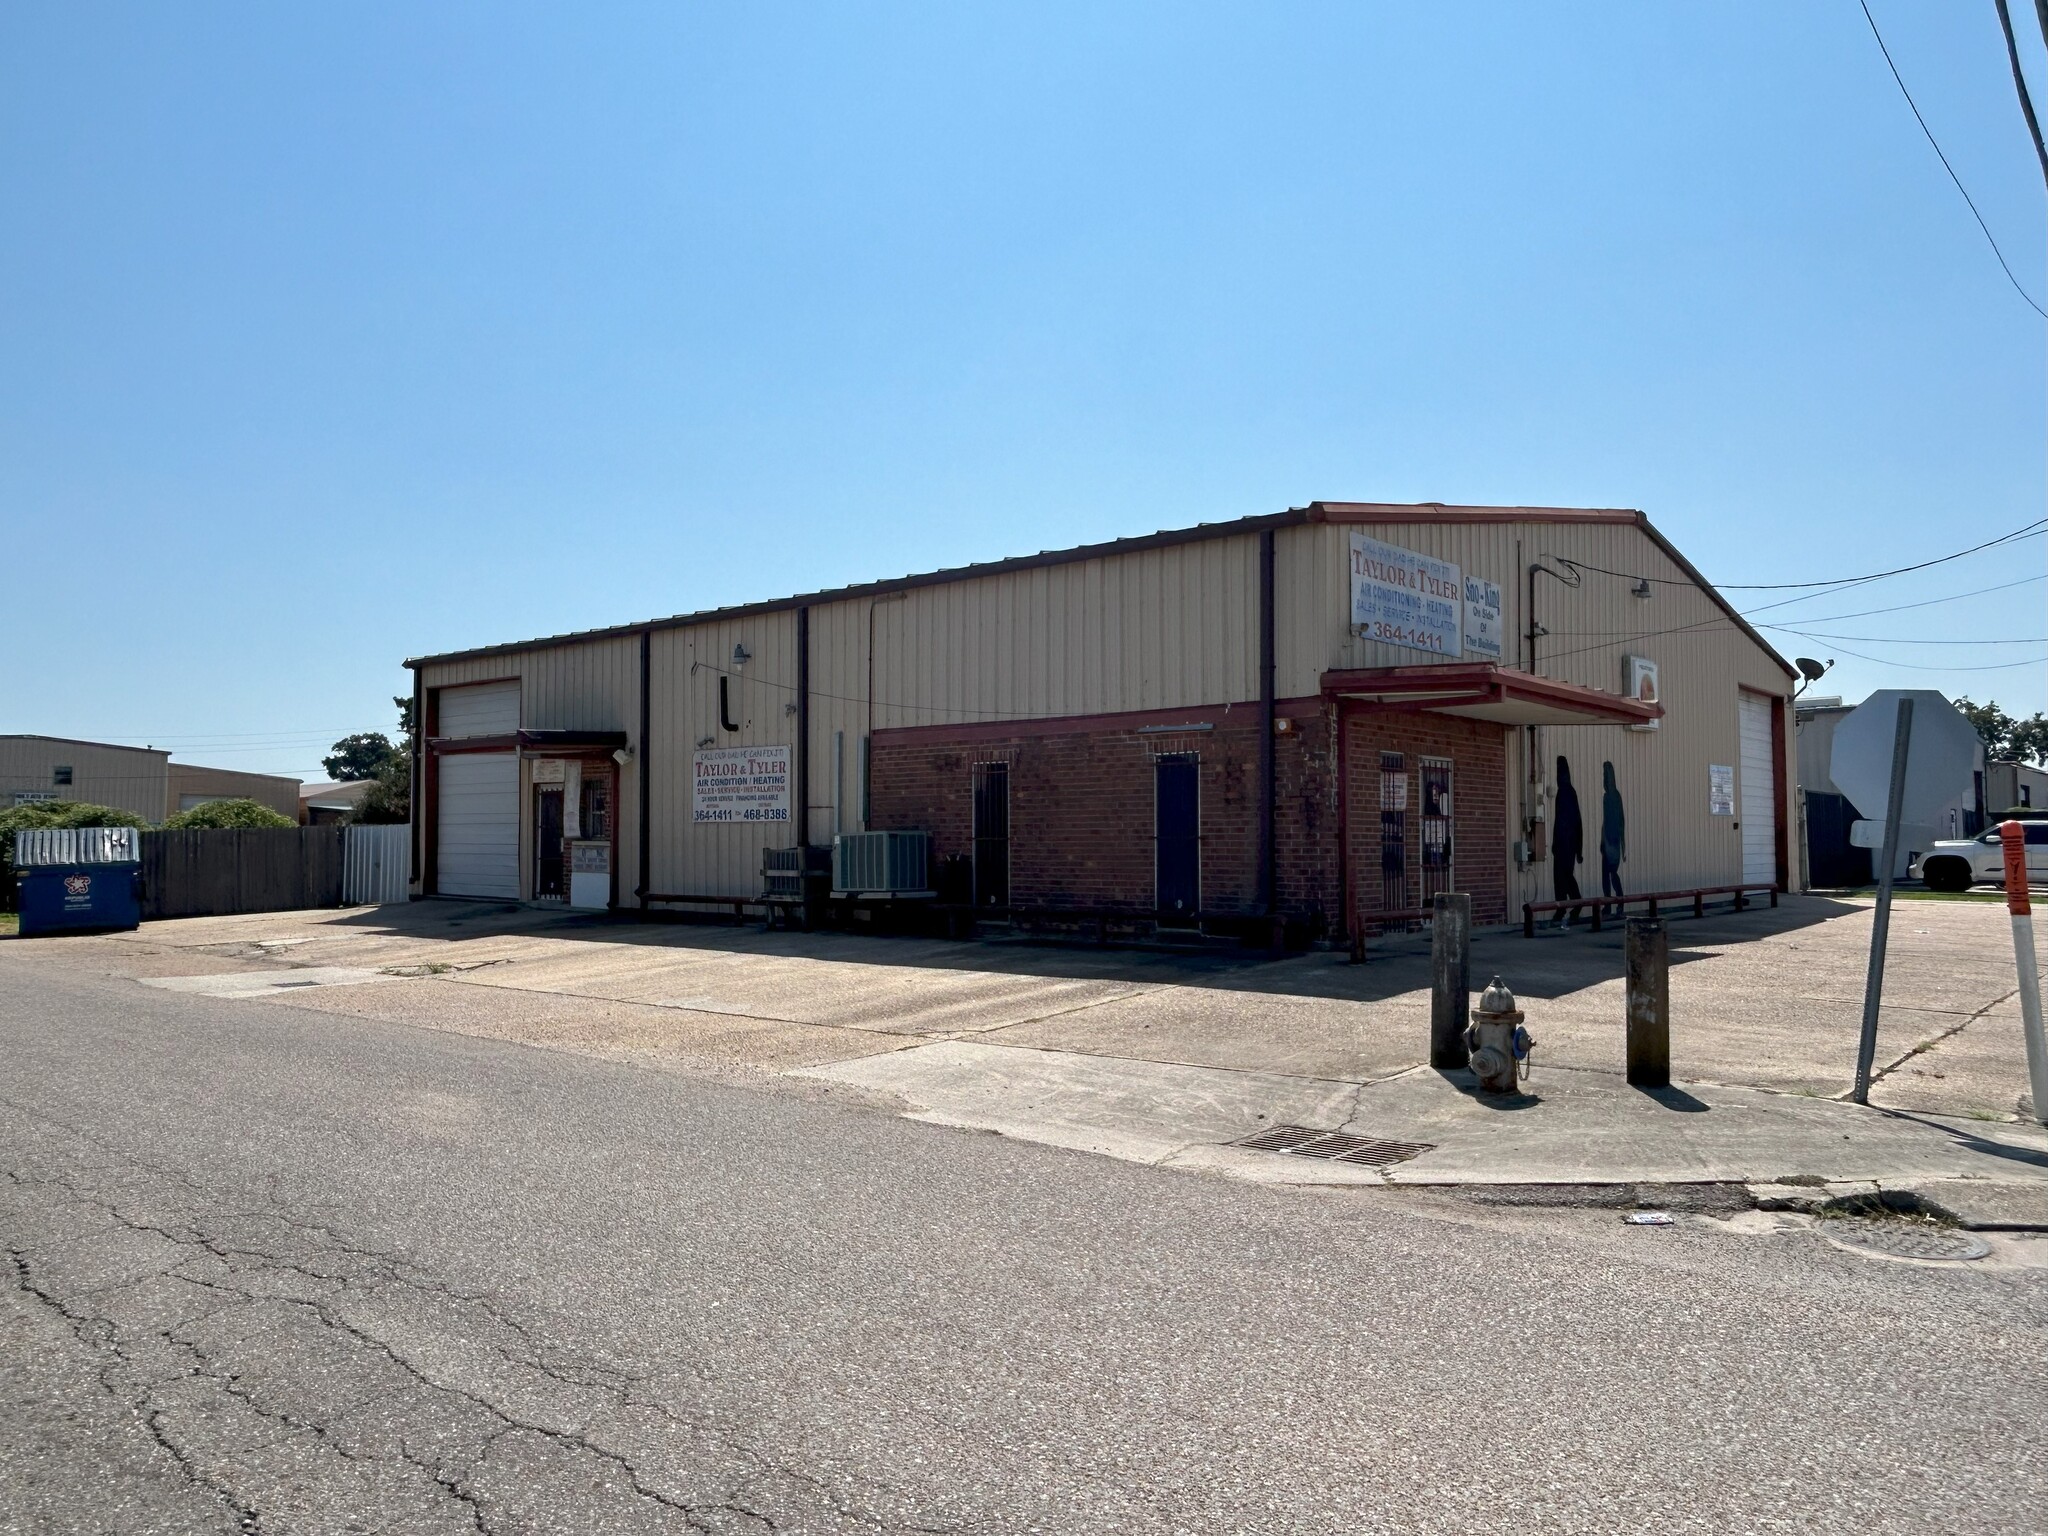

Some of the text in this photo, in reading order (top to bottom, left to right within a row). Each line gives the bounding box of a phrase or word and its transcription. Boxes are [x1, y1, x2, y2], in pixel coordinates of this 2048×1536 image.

[1353, 549, 1459, 600] TAYLOR & TYLER
[1361, 582, 1453, 617] AIR CONDITIONING HEATING
[1356, 599, 1377, 613] SALES
[1383, 605, 1410, 622] SERVICE
[1473, 606, 1494, 621] On Side
[1374, 621, 1442, 650] 364-1411
[1480, 622, 1487, 633] Of
[1465, 634, 1500, 655] The Building
[701, 752, 713, 761] CALL
[740, 750, 747, 759] HE
[750, 750, 762, 758] CAN
[695, 759, 786, 777] TAYLOR & TYLER
[697, 779, 709, 787] AIR
[710, 777, 747, 787] CONDITION
[753, 776, 785, 785] HEATING
[697, 785, 785, 795] SALES SERVICE INSTALLATION
[695, 809, 732, 821] 364-1411
